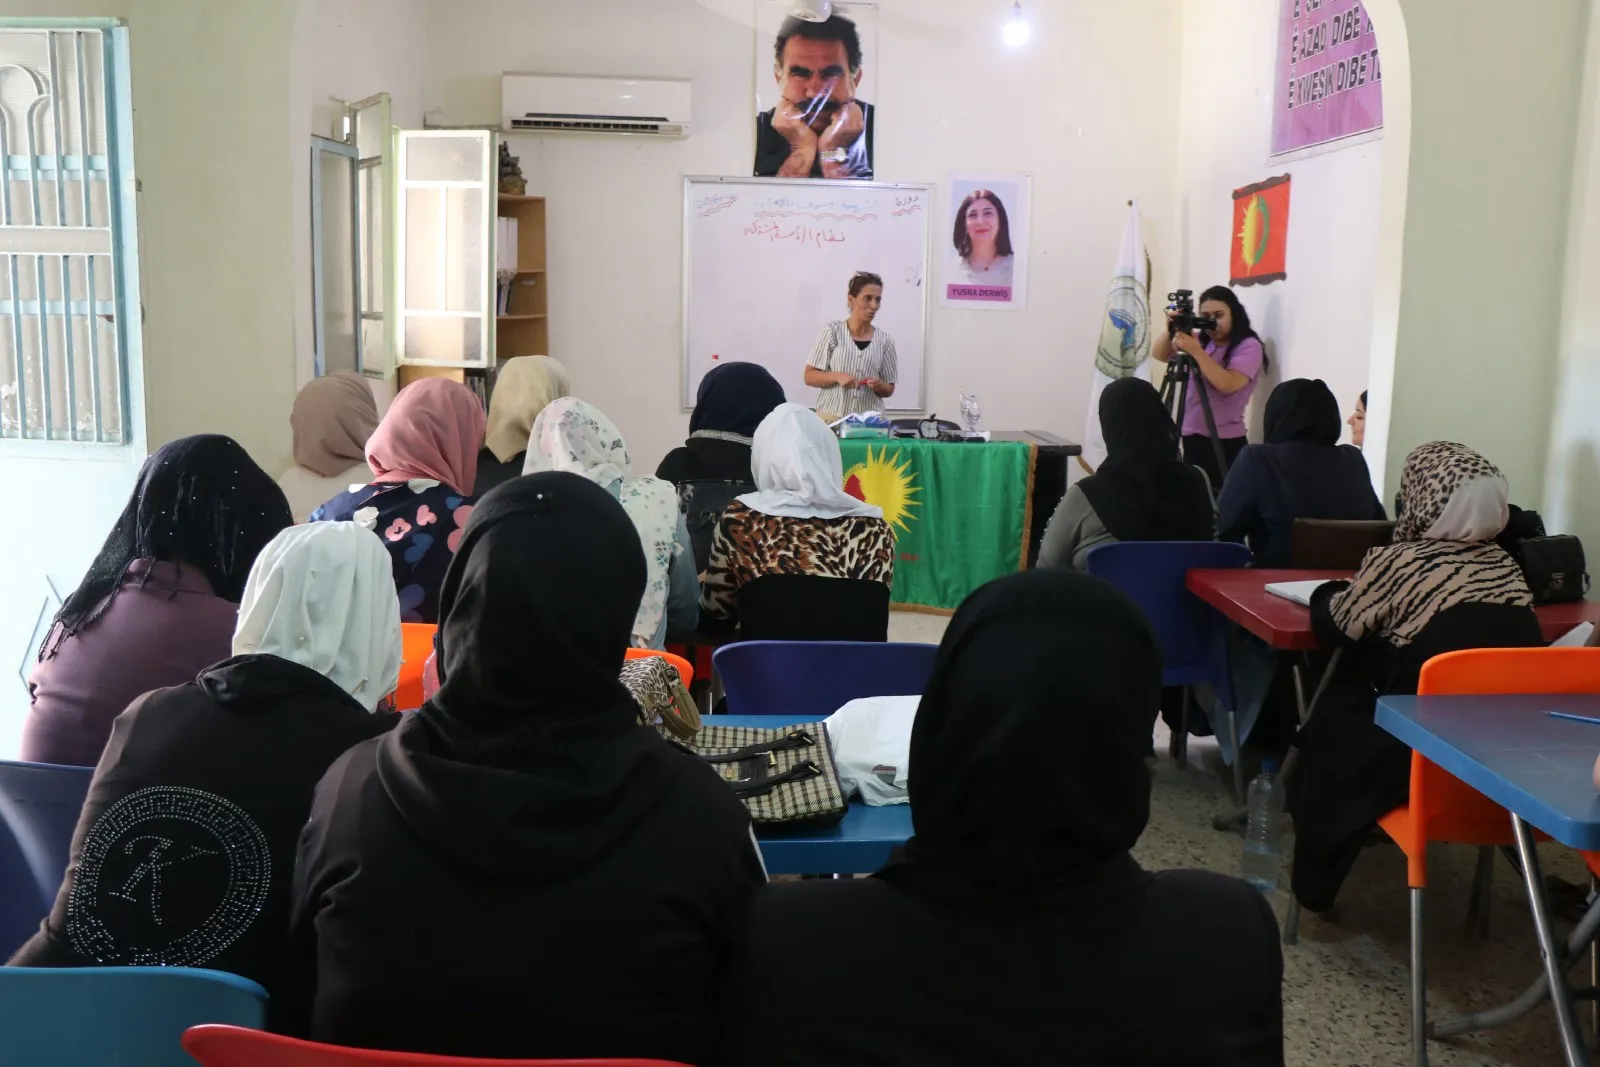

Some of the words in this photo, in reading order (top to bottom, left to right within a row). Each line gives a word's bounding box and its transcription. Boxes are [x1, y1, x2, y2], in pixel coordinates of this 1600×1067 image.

[1299, 22, 1327, 60] AZAD
[1331, 6, 1360, 47] DIBE
[1337, 53, 1367, 92] DIBE
[952, 288, 977, 296] YUSRA
